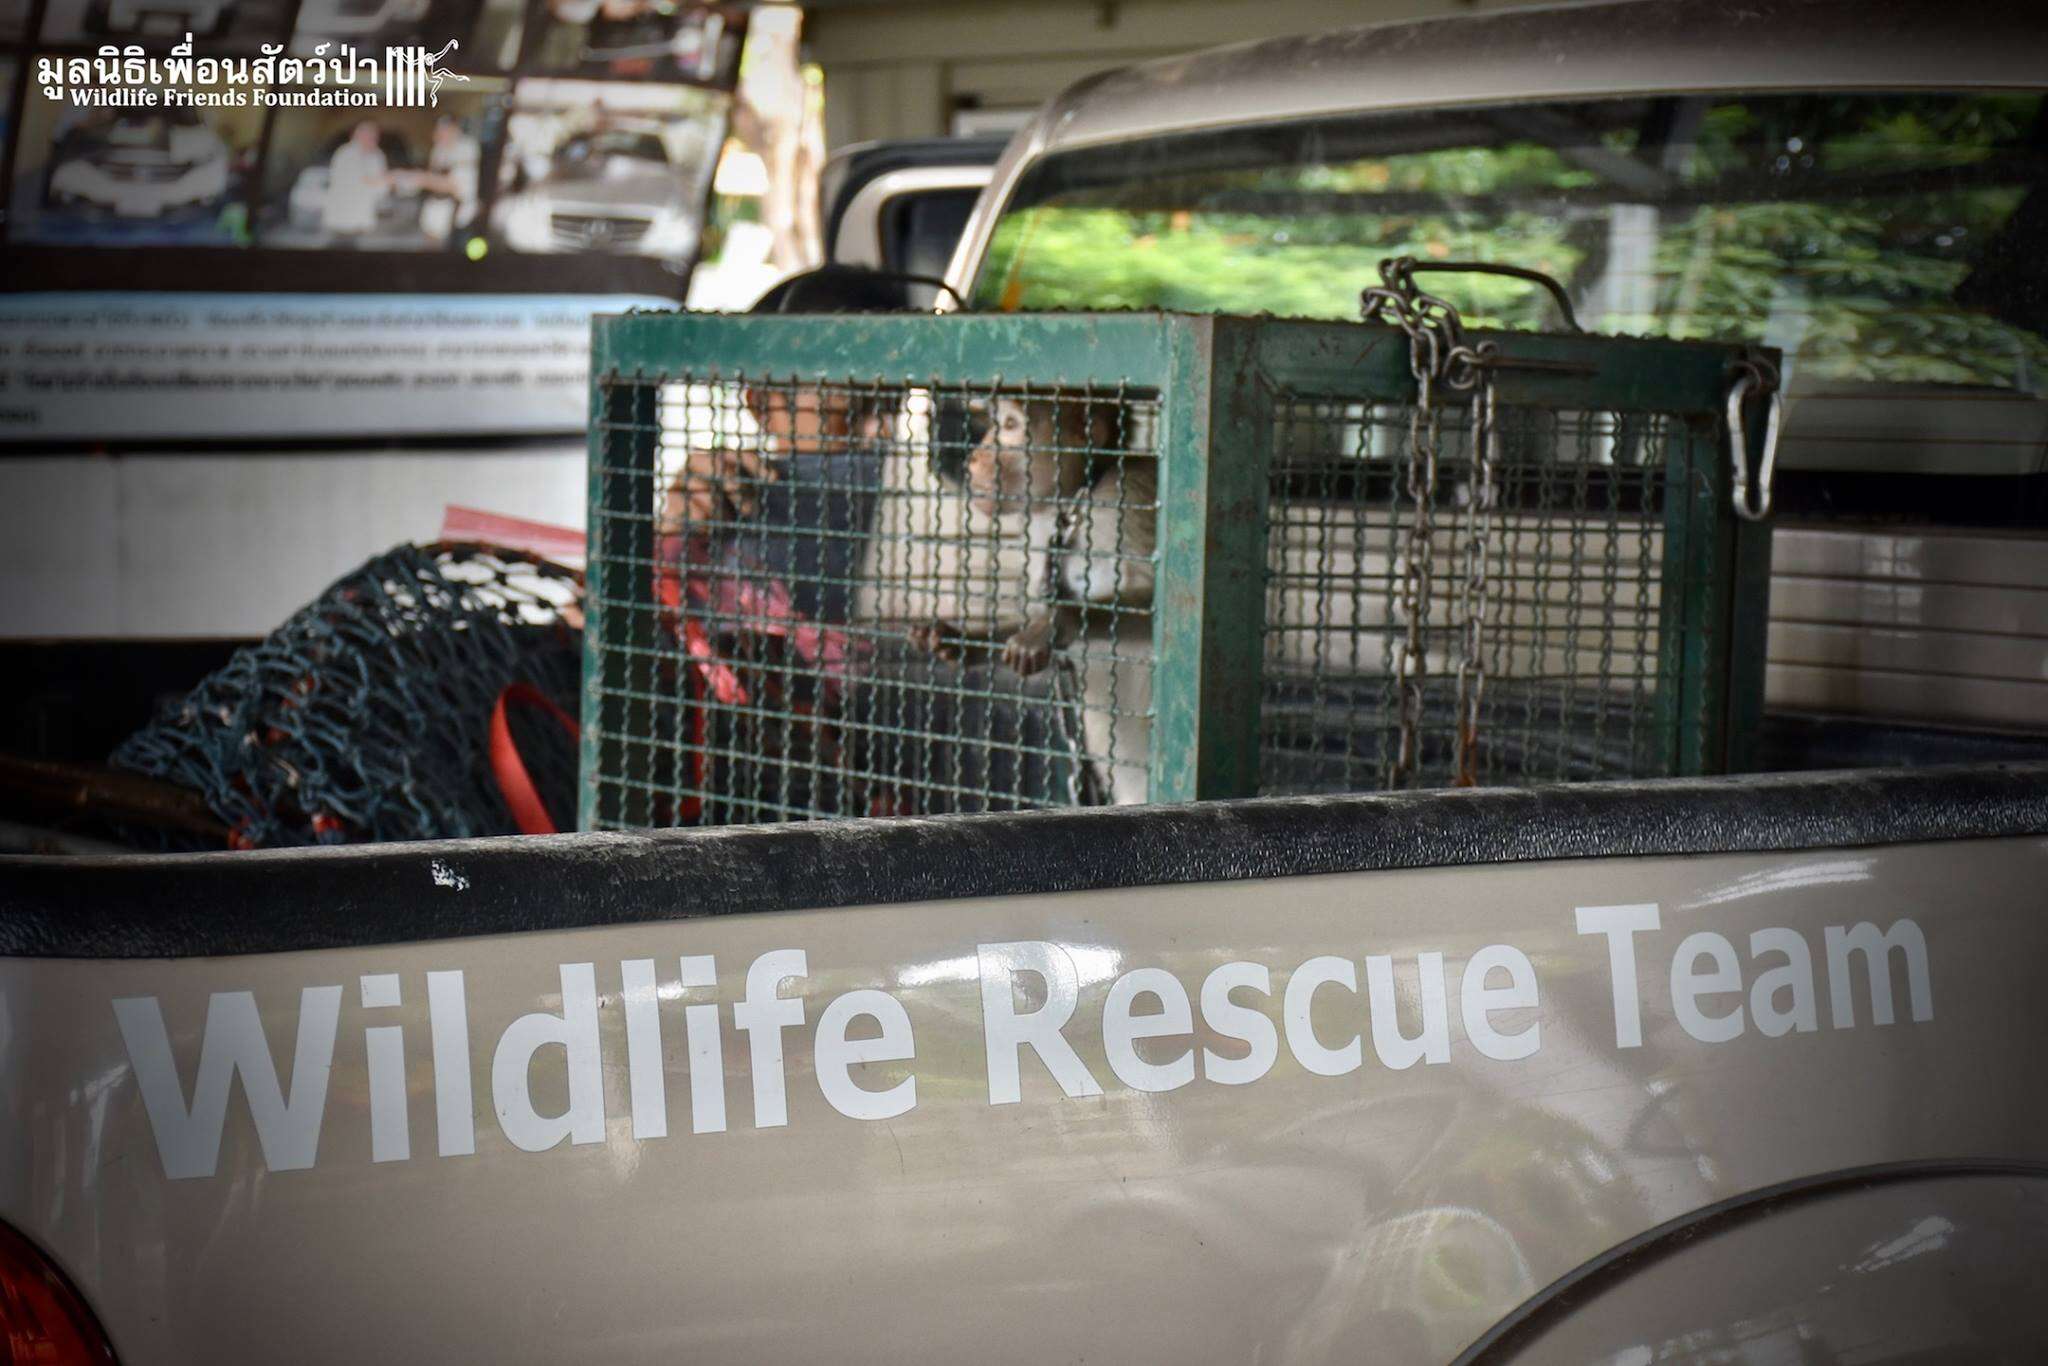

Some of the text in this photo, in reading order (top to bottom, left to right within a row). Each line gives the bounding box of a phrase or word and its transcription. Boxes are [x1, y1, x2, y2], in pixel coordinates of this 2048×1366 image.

[111, 903, 1934, 1180] Wildlife Rescue Team
